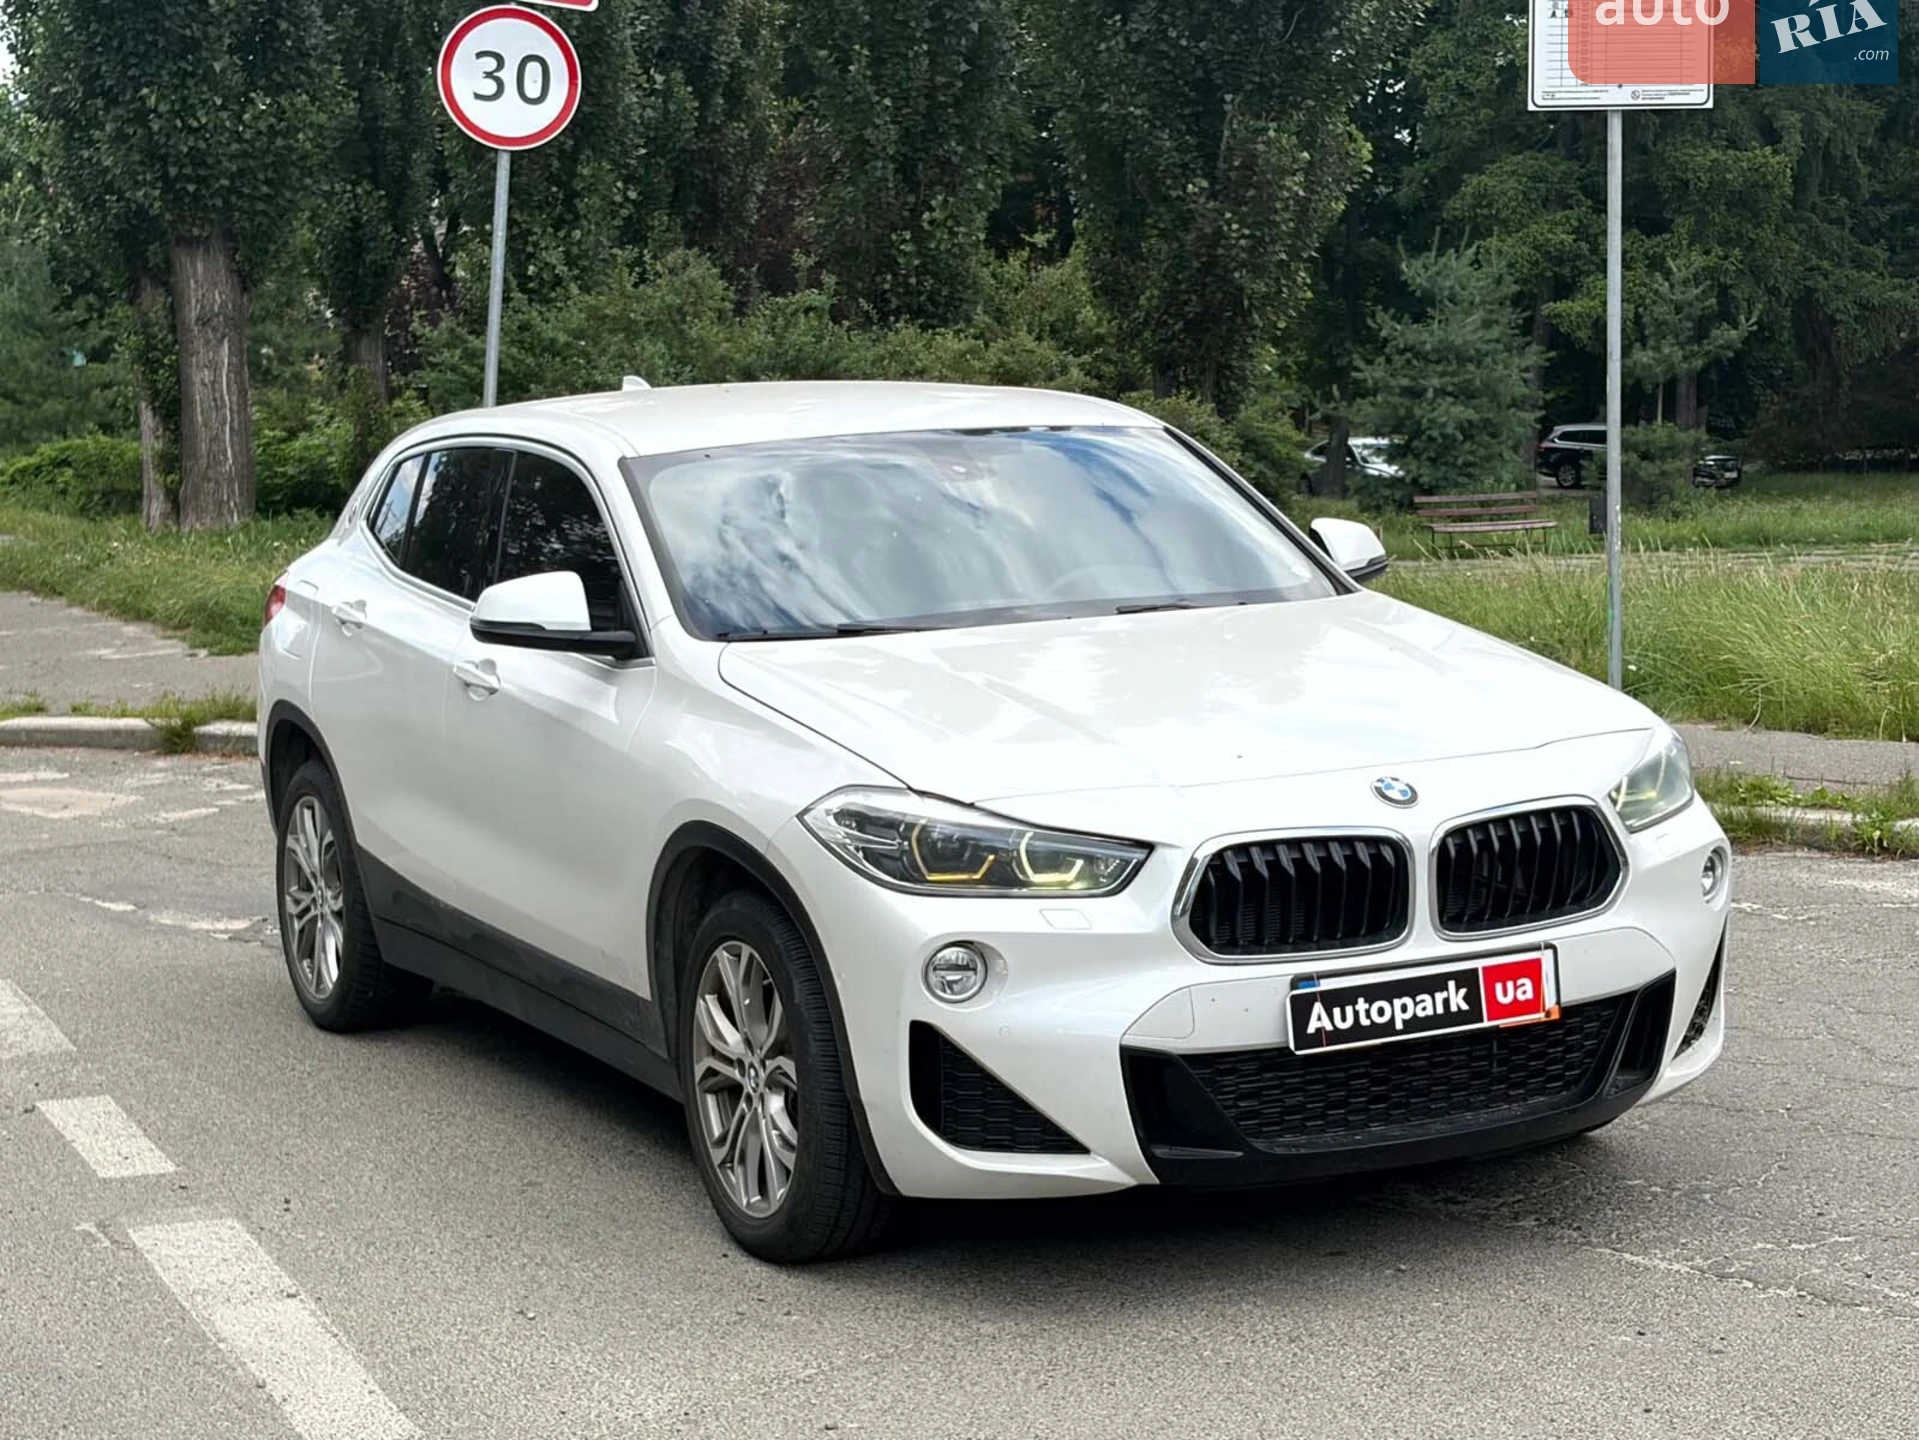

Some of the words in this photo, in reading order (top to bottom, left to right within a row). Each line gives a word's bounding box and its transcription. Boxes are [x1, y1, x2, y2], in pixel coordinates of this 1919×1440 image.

[472, 50, 551, 106] 30
[1306, 979, 1470, 1034] Autopark
[1494, 977, 1534, 1005] ua
